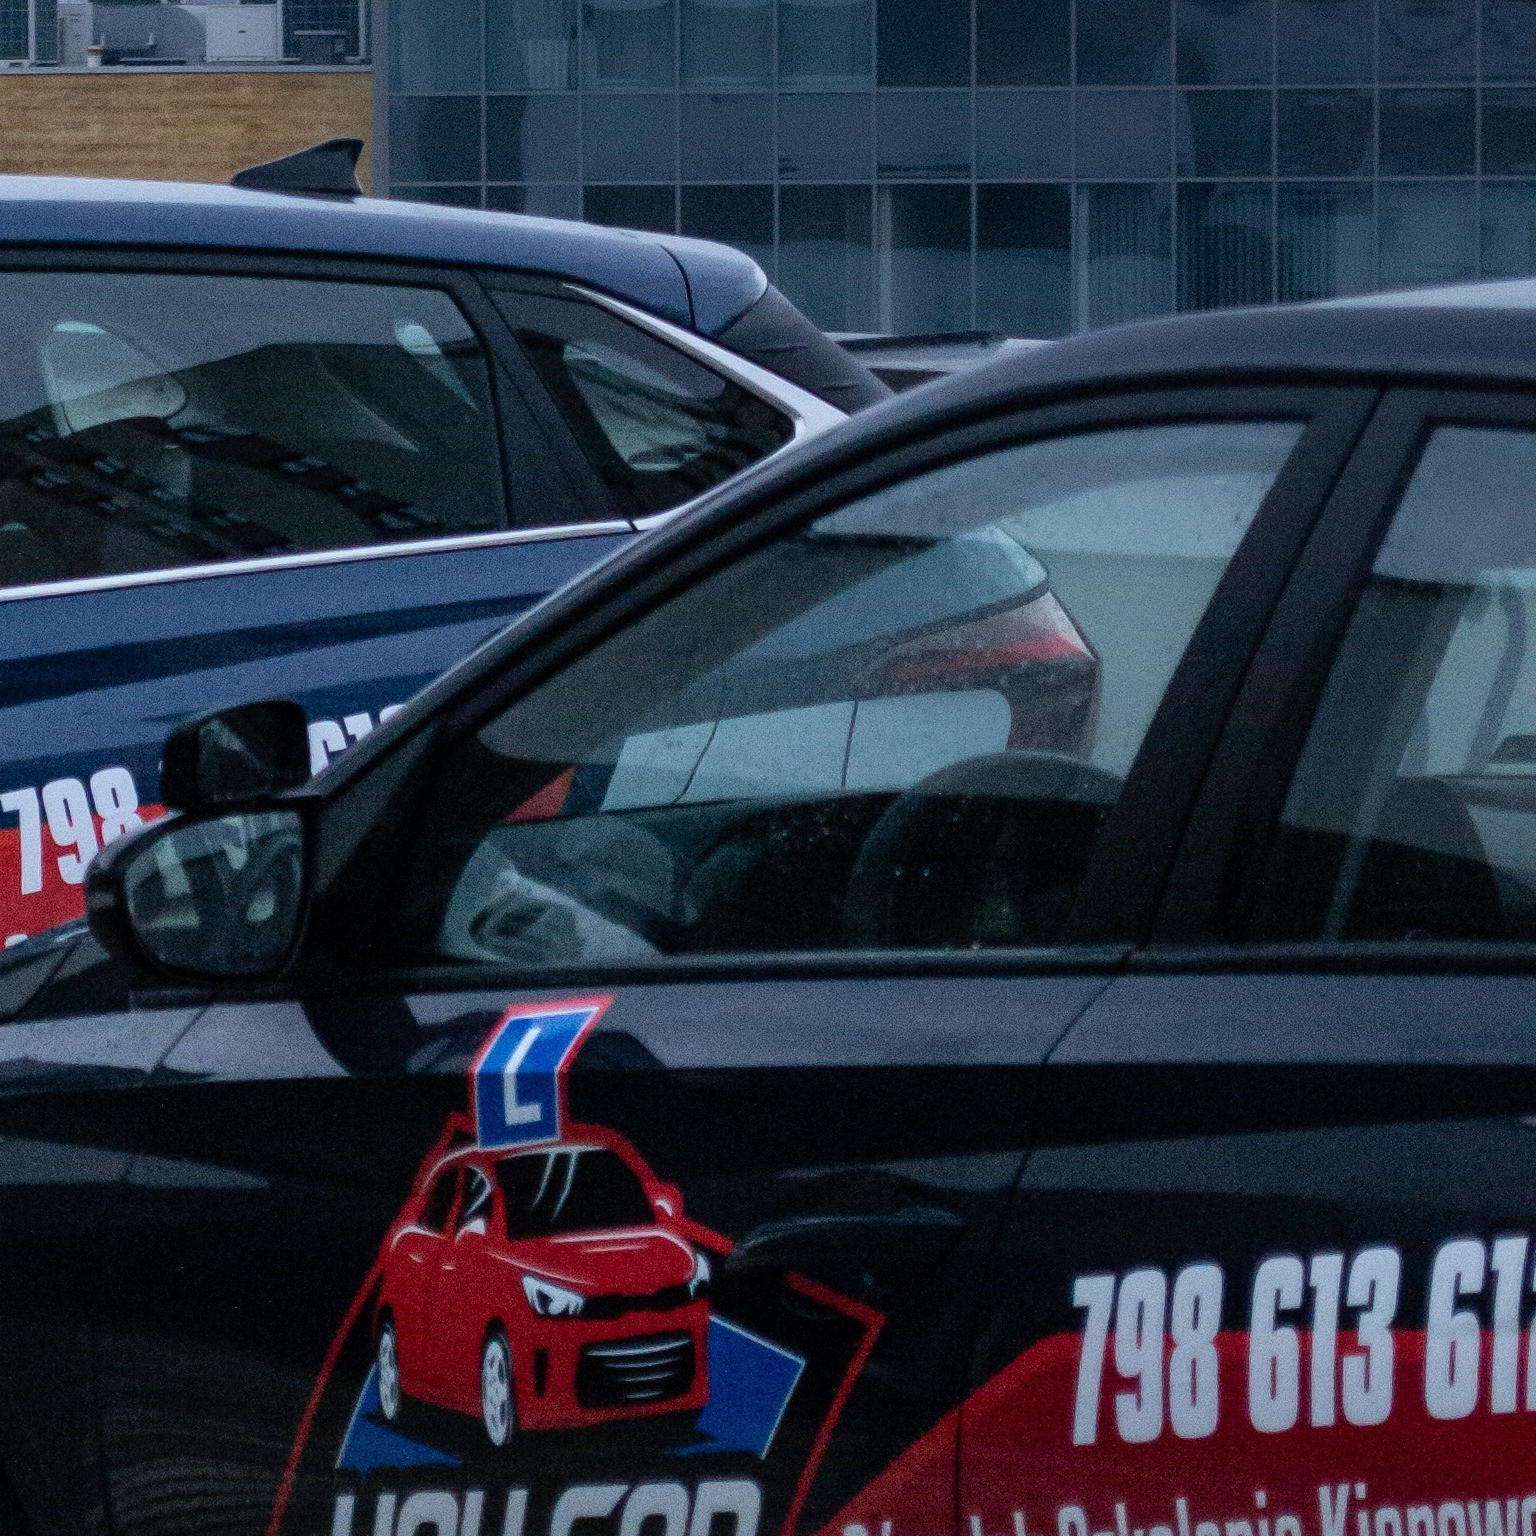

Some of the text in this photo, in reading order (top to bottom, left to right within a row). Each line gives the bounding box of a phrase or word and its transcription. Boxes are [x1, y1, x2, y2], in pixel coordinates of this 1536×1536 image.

[0, 767, 144, 896] 798
[503, 1027, 543, 1126] L
[1073, 1237, 1536, 1447] 798 613 61
